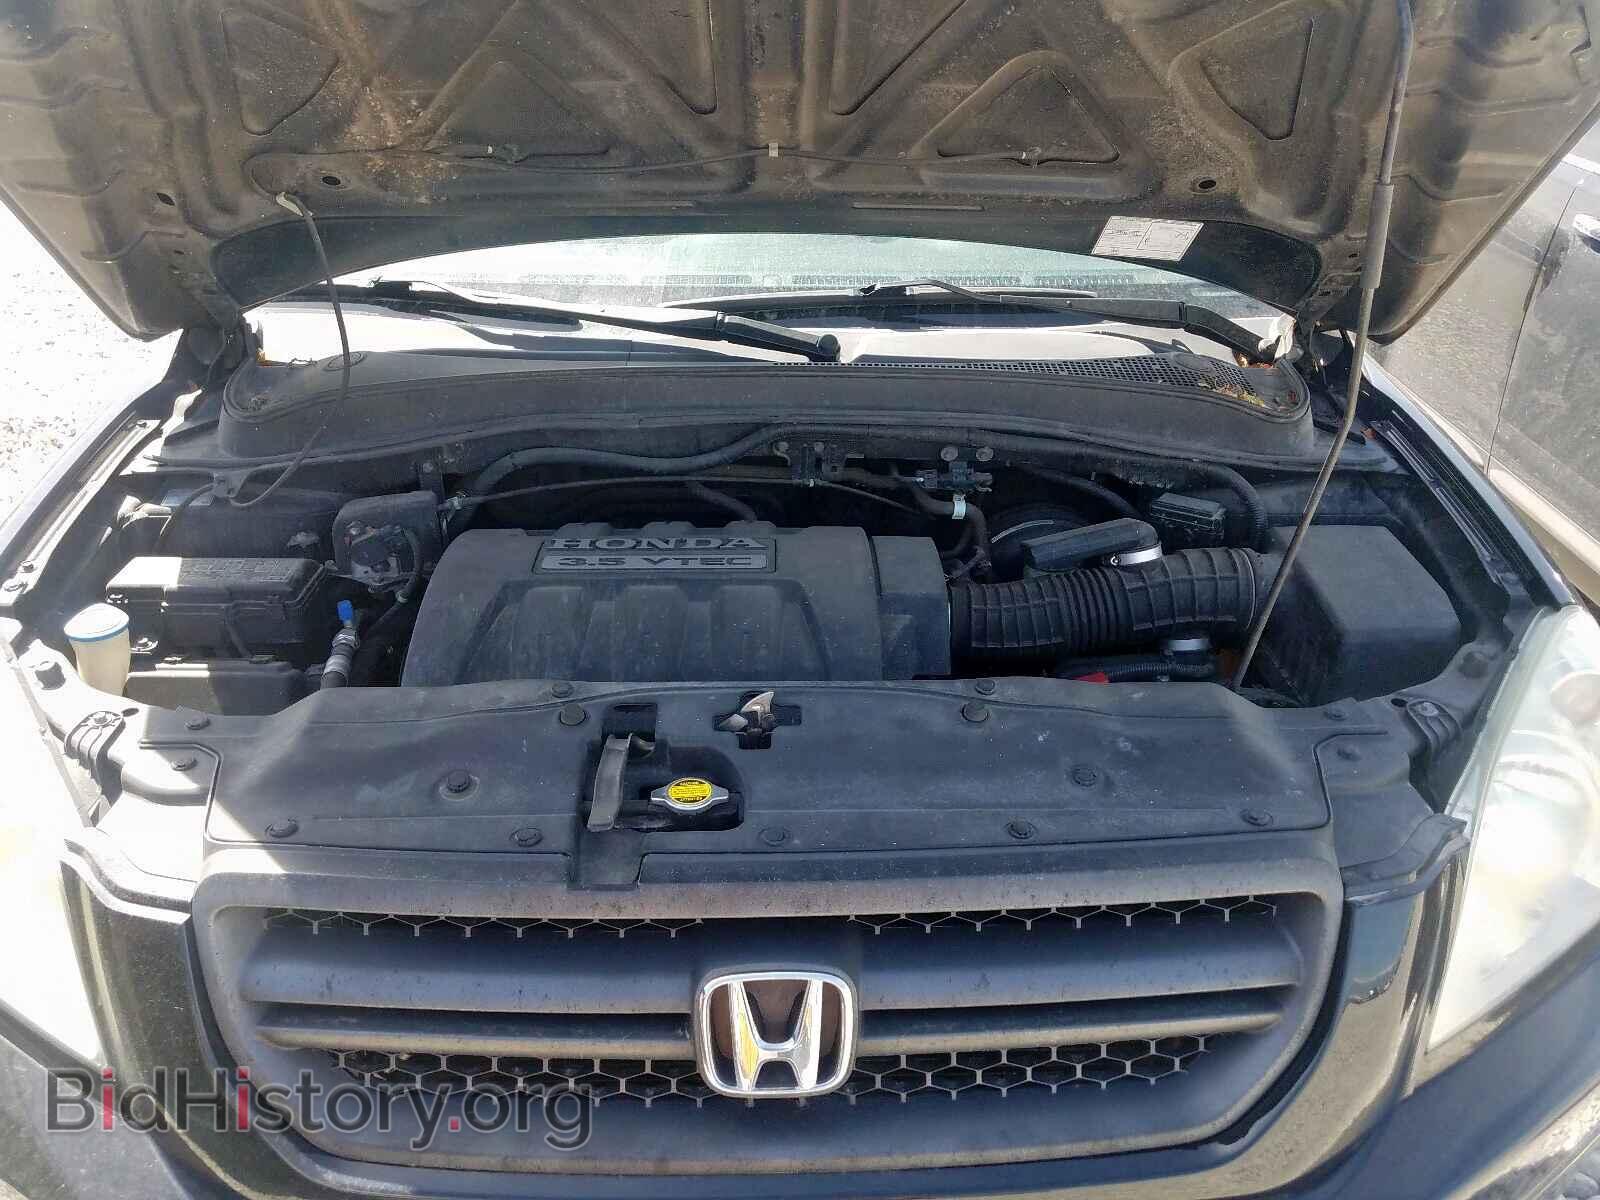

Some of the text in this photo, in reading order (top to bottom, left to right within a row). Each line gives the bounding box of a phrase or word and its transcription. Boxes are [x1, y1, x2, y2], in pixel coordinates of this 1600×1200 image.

[546, 536, 768, 550] HONDA
[558, 556, 753, 567] 3.5 VTEC
